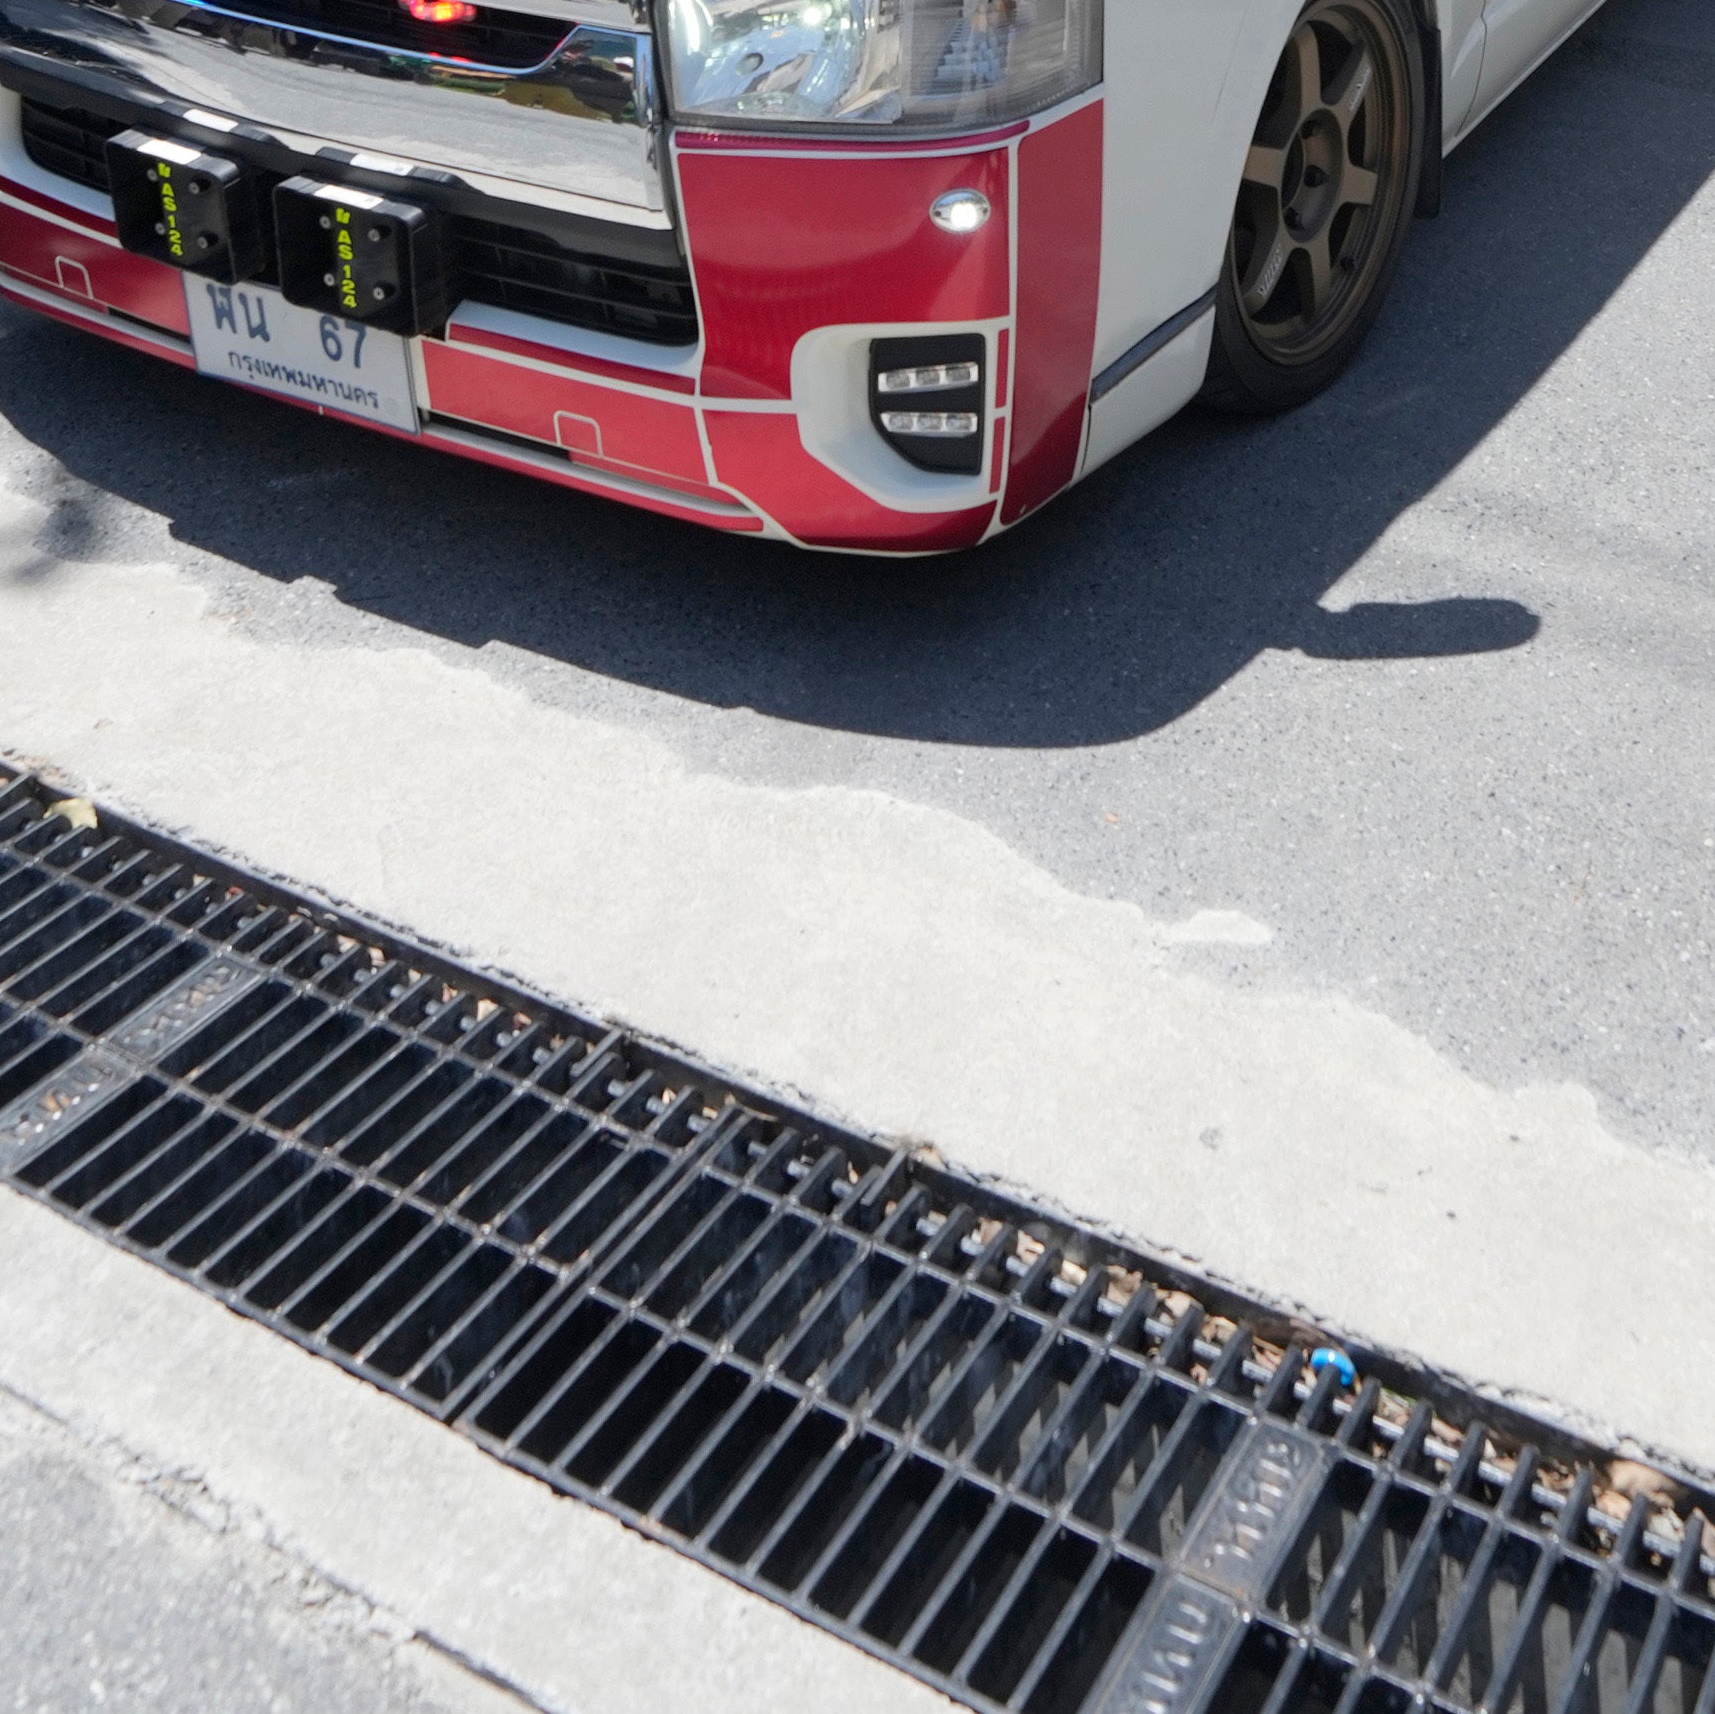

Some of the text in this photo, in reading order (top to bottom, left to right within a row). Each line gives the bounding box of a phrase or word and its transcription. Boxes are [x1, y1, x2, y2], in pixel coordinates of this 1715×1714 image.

[320, 314, 367, 369] 67
[228, 351, 379, 408] กรุงเทพมหานคร
